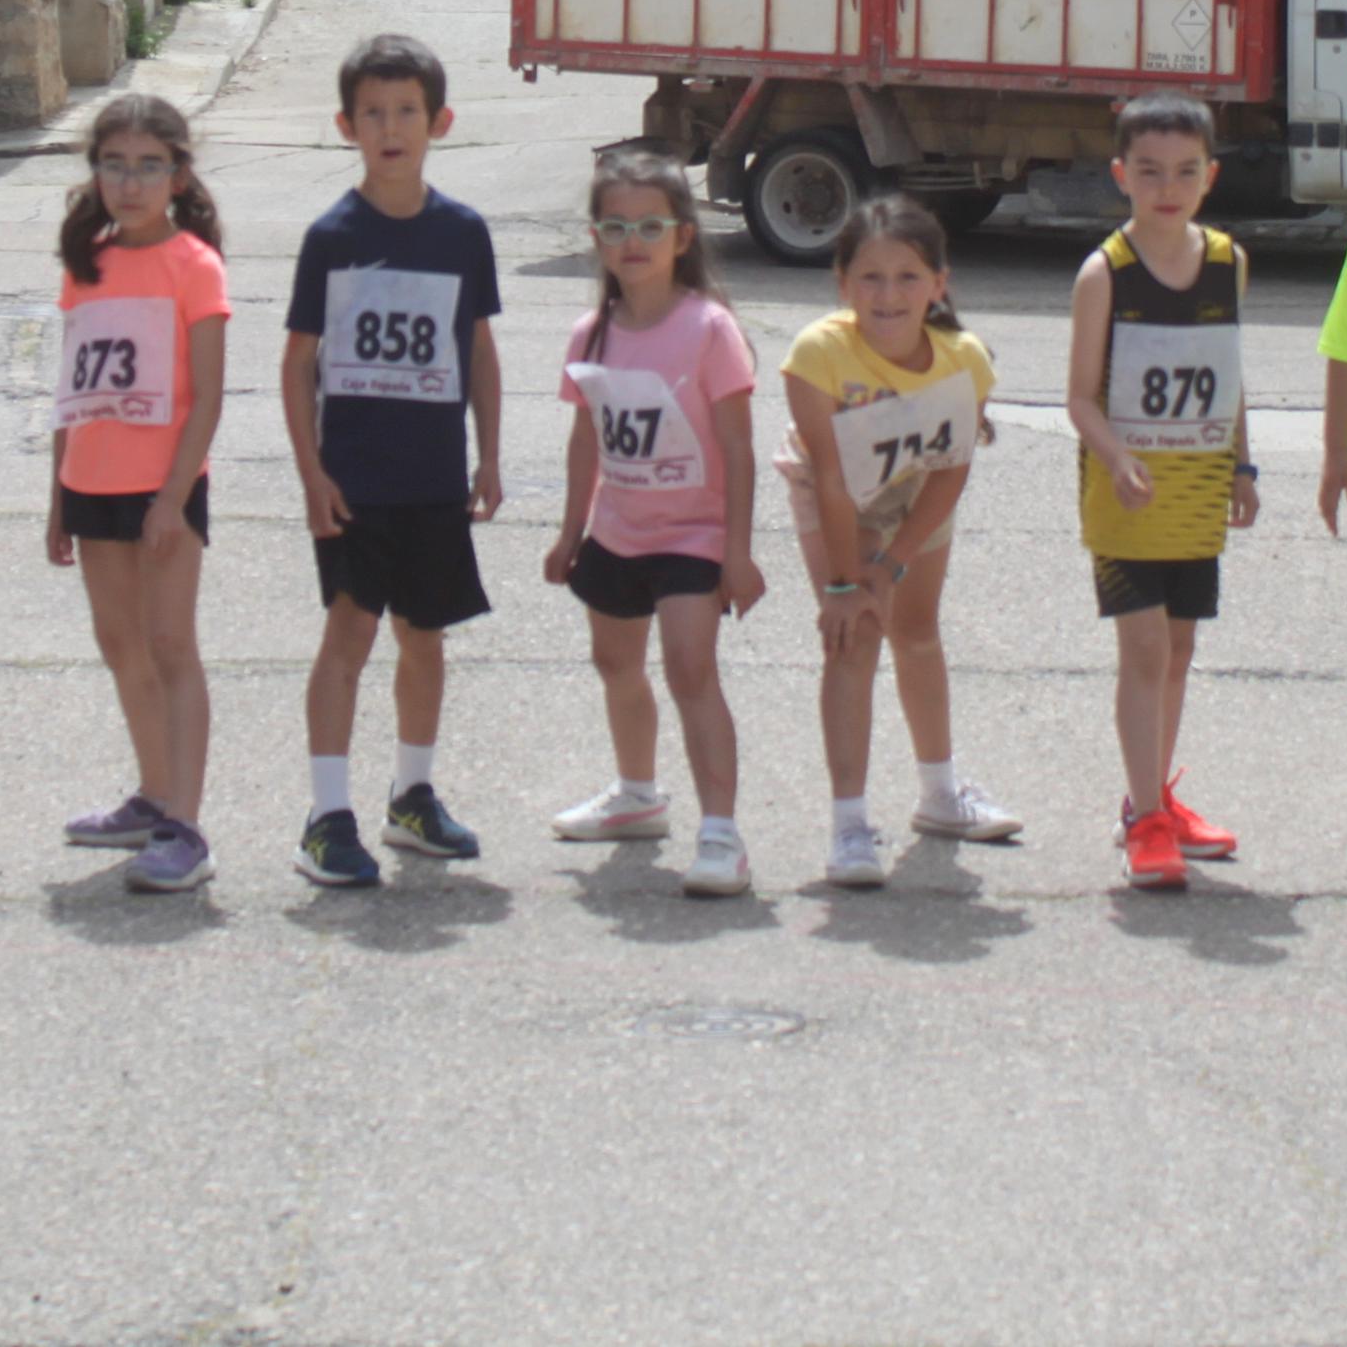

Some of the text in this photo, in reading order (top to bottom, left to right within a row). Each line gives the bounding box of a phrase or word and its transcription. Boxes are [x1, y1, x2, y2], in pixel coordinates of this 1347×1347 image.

[72, 338, 136, 391] 873
[355, 310, 436, 366] 858
[1142, 366, 1216, 418] 879
[603, 404, 662, 459] 867
[873, 419, 951, 485] 714
